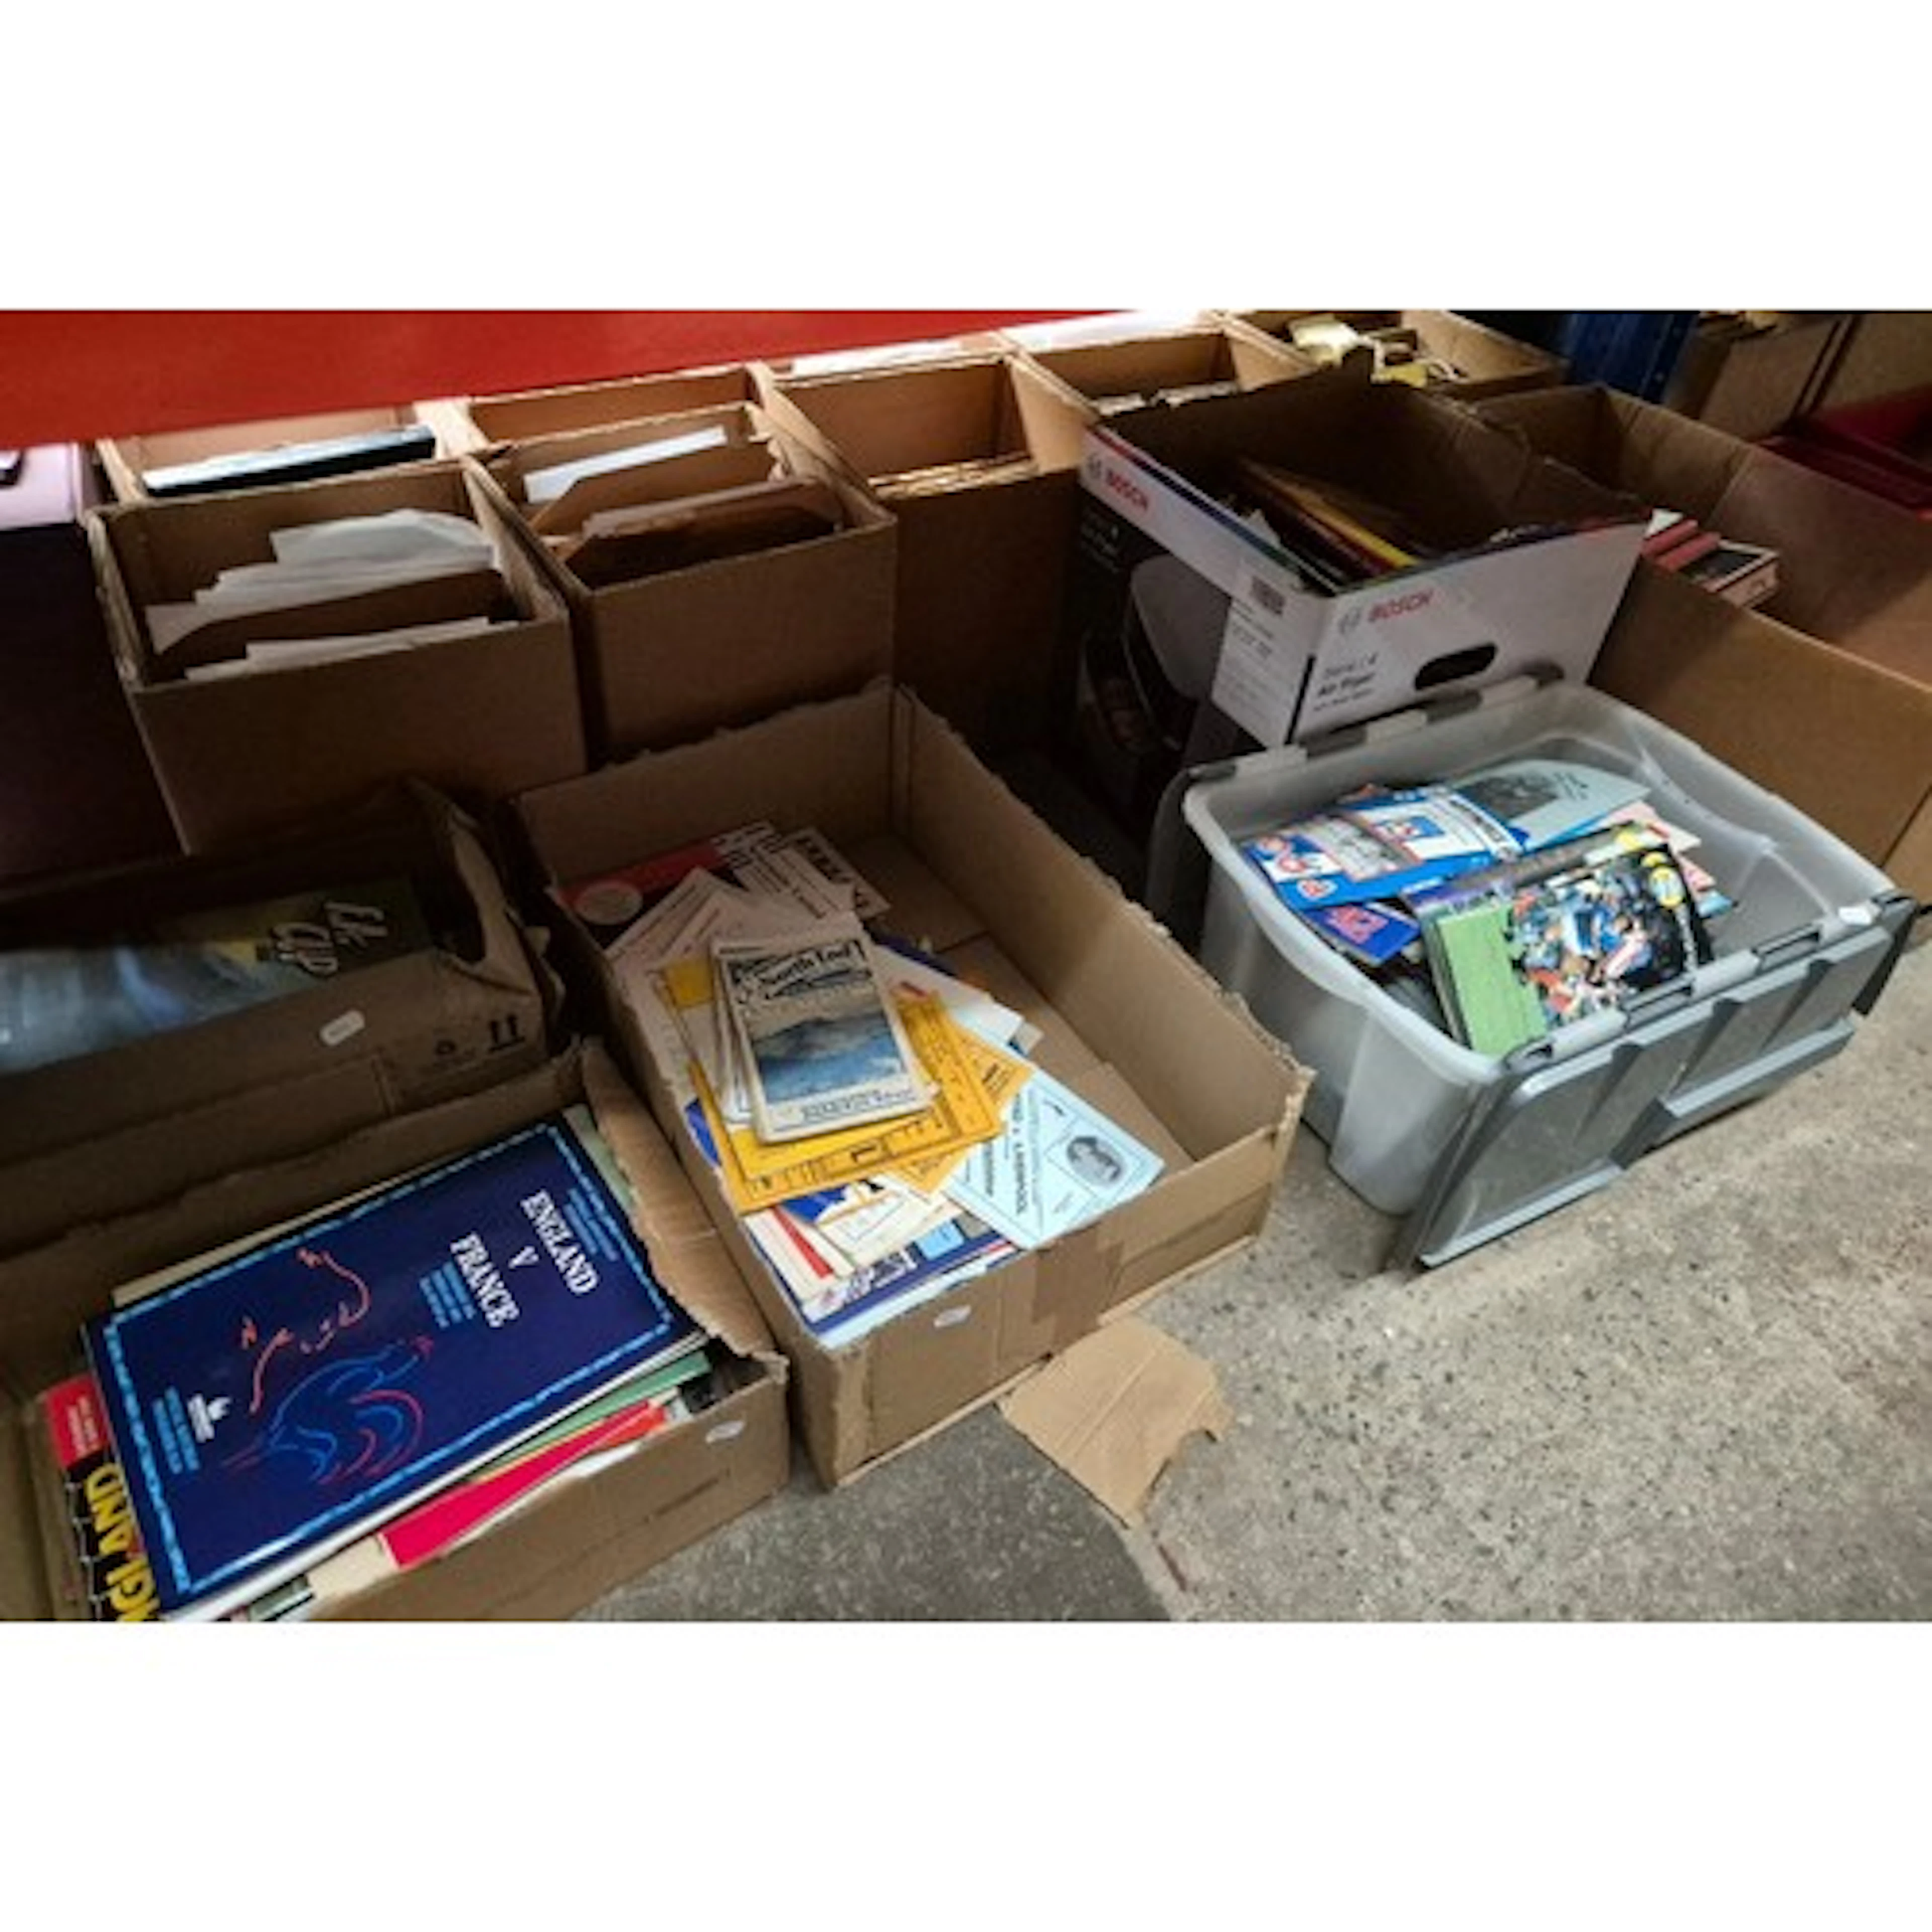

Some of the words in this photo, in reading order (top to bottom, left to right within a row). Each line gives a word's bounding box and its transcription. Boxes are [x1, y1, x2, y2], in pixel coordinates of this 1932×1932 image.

[1367, 588, 1436, 624] BOSCH
[450, 1231, 521, 1328] FRANCE
[520, 1188, 601, 1298] ENGLAND
